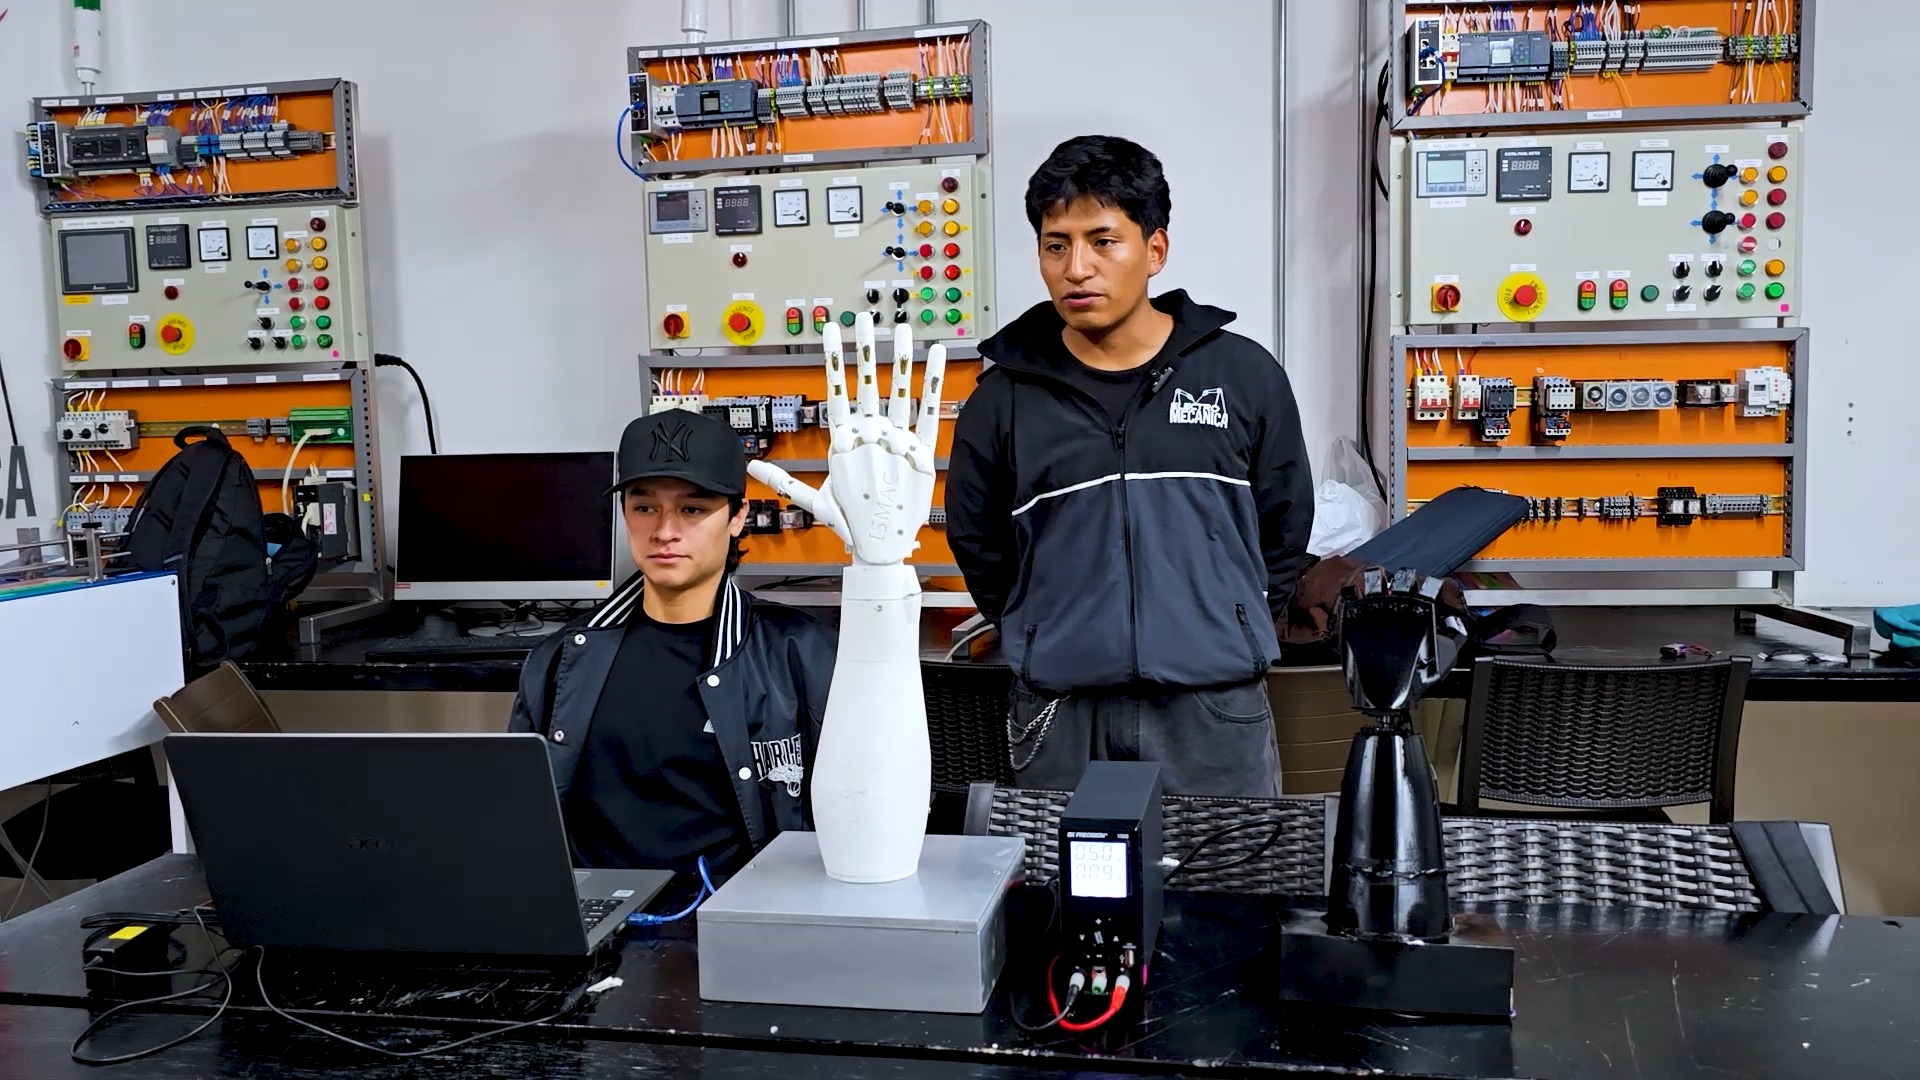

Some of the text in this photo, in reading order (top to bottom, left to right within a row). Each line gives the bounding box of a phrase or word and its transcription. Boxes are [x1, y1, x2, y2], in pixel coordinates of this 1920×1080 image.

[1170, 408, 1228, 429] MECANICA
[0, 445, 37, 519] A
[868, 472, 899, 541] ISMAC
